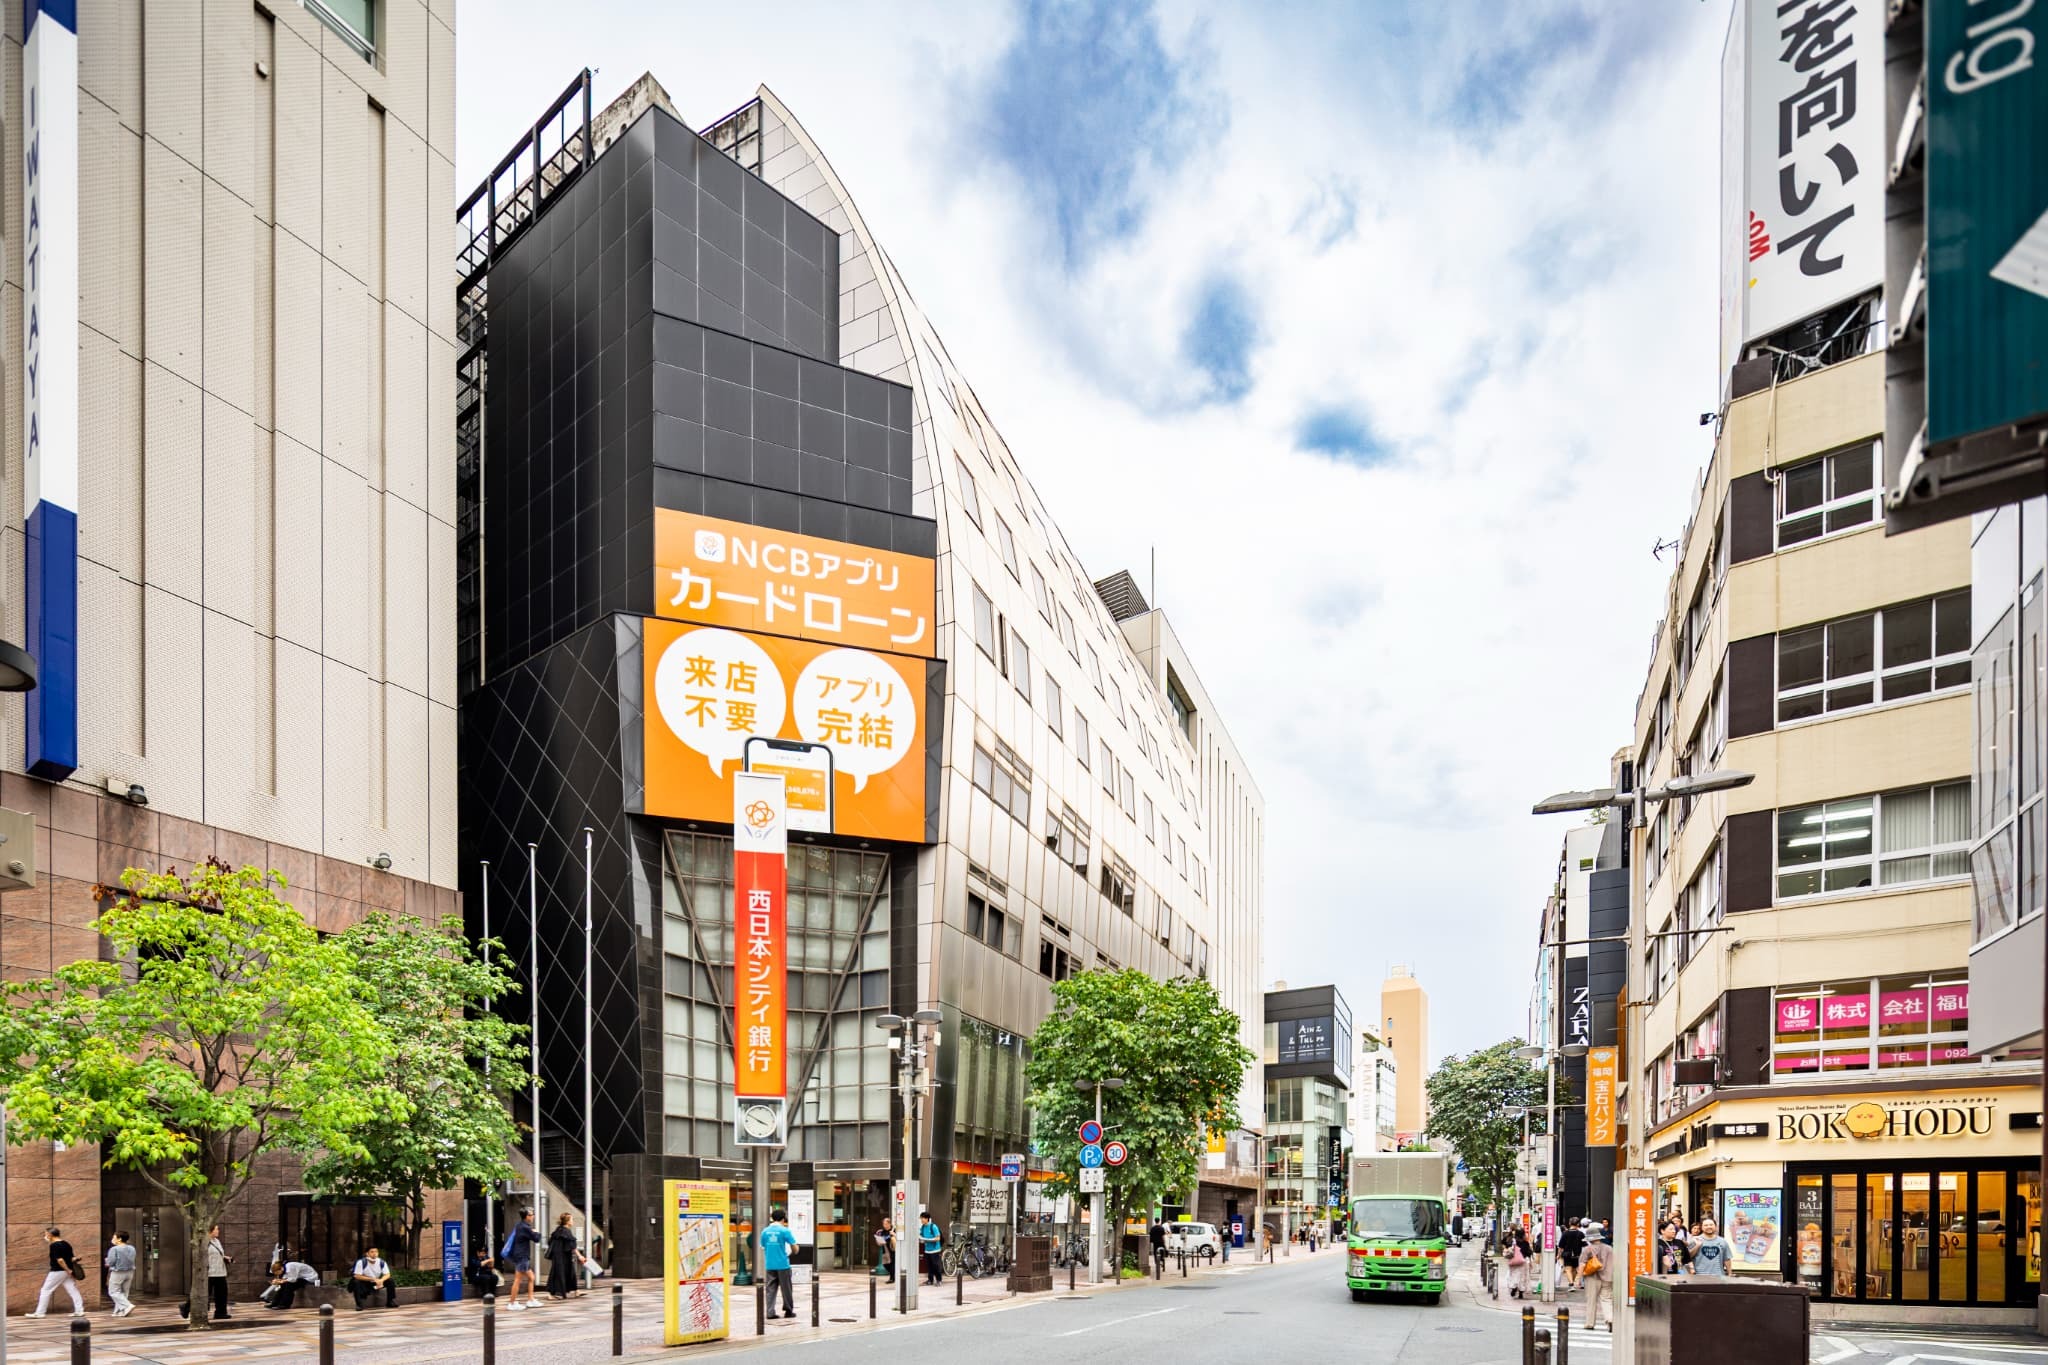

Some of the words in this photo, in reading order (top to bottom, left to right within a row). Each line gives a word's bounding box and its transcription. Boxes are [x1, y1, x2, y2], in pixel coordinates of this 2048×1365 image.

[1777, 0, 1858, 277] を向いて
[26, 85, 39, 459] IWATAYA
[731, 536, 899, 592] NCBアプリ
[670, 567, 926, 645] カードローン
[684, 655, 758, 694] 来店
[815, 674, 894, 708] アプリ
[684, 694, 758, 734] 不要
[817, 707, 894, 750] 完結
[747, 889, 772, 1073] 西日本シティ銀行
[1891, 1052, 1913, 1062] TEL
[1945, 1049, 1967, 1059] 092
[1594, 1080, 1609, 1141] 宝石バンク
[1776, 1112, 1847, 1141] BOK
[1886, 1106, 1996, 1137] HODU
[1085, 1149, 1094, 1165] P
[1109, 1148, 1121, 1159] 30
[1807, 1190, 1818, 1202] 3
